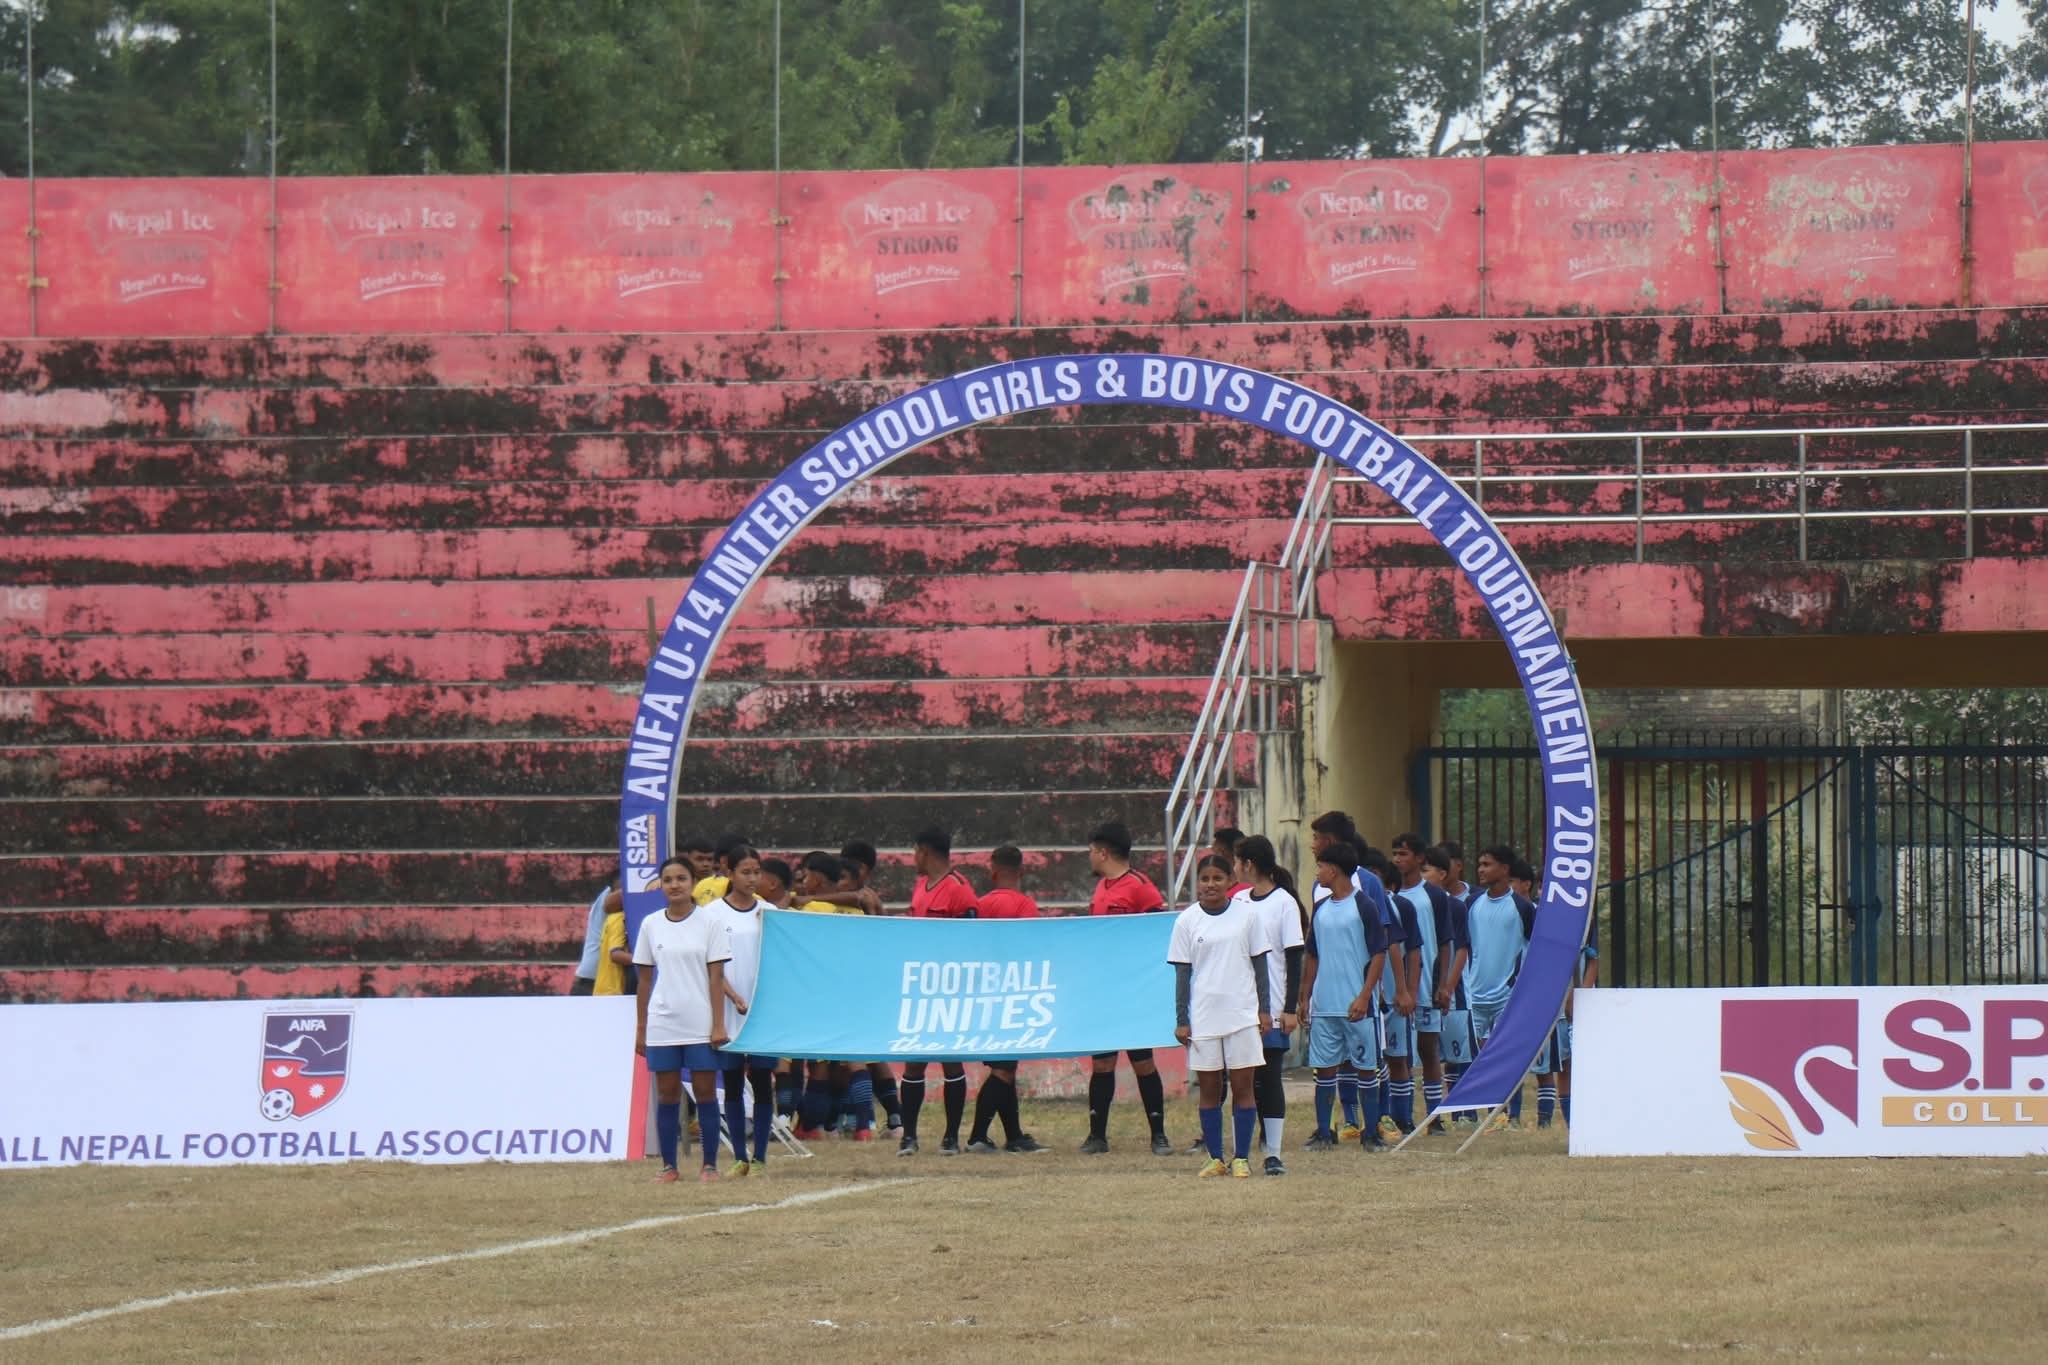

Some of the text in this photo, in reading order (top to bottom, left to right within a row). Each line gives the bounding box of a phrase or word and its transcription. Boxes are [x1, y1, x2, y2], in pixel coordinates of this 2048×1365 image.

[864, 200, 971, 230] Nepal Ice
[1320, 189, 1428, 219] Nepal Ice
[422, 207, 456, 229] Ice
[1332, 224, 1416, 245] STRONG
[1571, 220, 1656, 241] STRONG
[877, 234, 959, 255] STRONG
[874, 264, 960, 288] Nepal's Pride
[1330, 255, 1377, 278] Nepal's
[627, 358, 1594, 908] ANFA U-14 INTER SCHOOL GIRLS & BOYS FOOTBALL TOURNAMENT 2082
[902, 960, 1057, 995] FOOTBALL
[897, 992, 1056, 1034] UNITES
[1423, 1008, 1431, 1026] 5
[288, 1018, 328, 1032] ANFA
[888, 1027, 1057, 1052] the World
[1451, 1040, 1461, 1057] 8
[1913, 1102, 2034, 1122] COLL
[0, 1128, 613, 1163] LL NEPAL FOOTBALL ASSOCIATION
